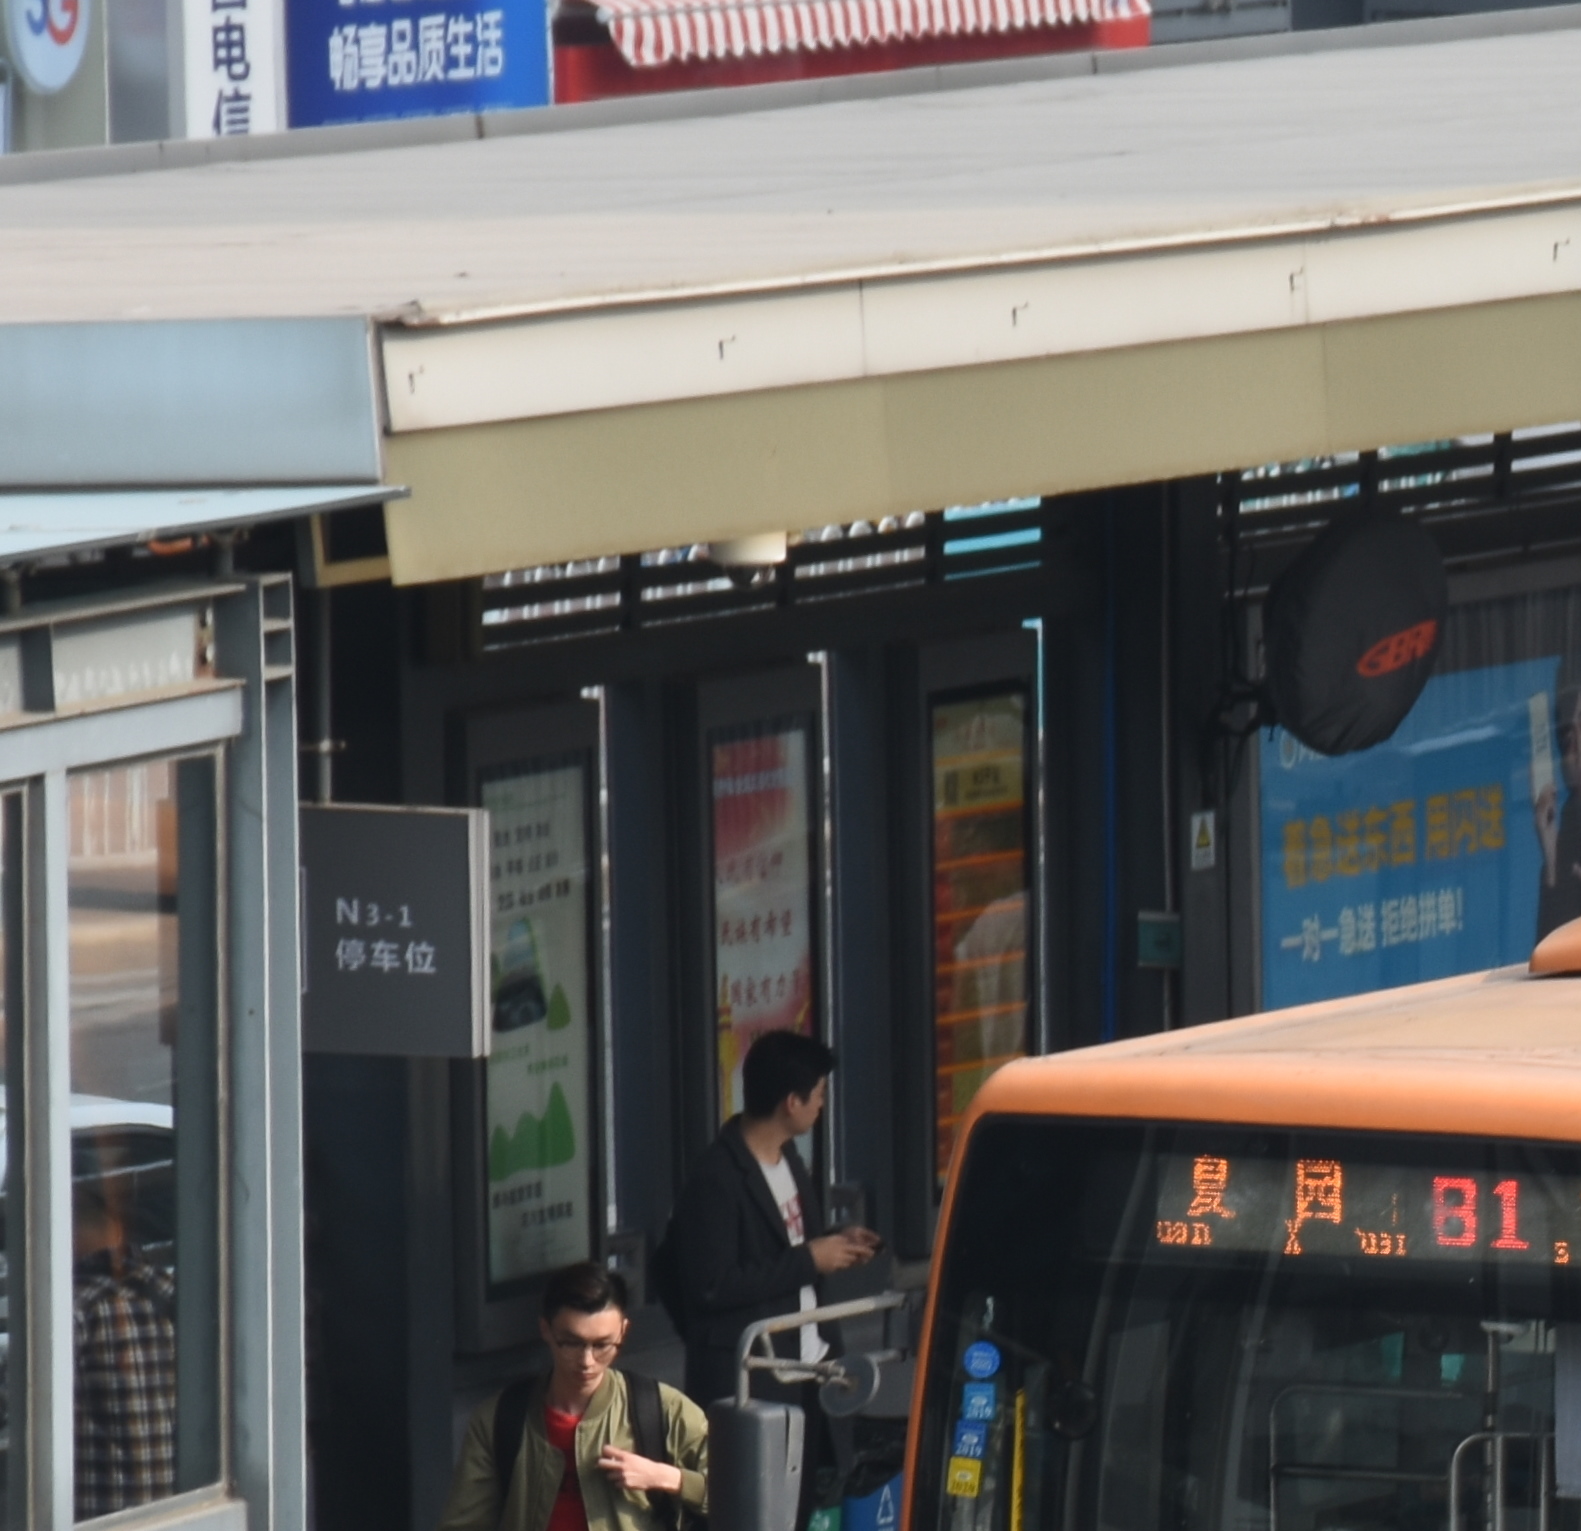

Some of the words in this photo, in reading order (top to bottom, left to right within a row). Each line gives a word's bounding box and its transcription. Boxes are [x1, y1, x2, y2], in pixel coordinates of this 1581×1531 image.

[212, 0, 251, 136] 电信
[329, 11, 504, 91] 畅享品质生活
[334, 938, 437, 975] 停车位
[1433, 1175, 1530, 1250] B1
